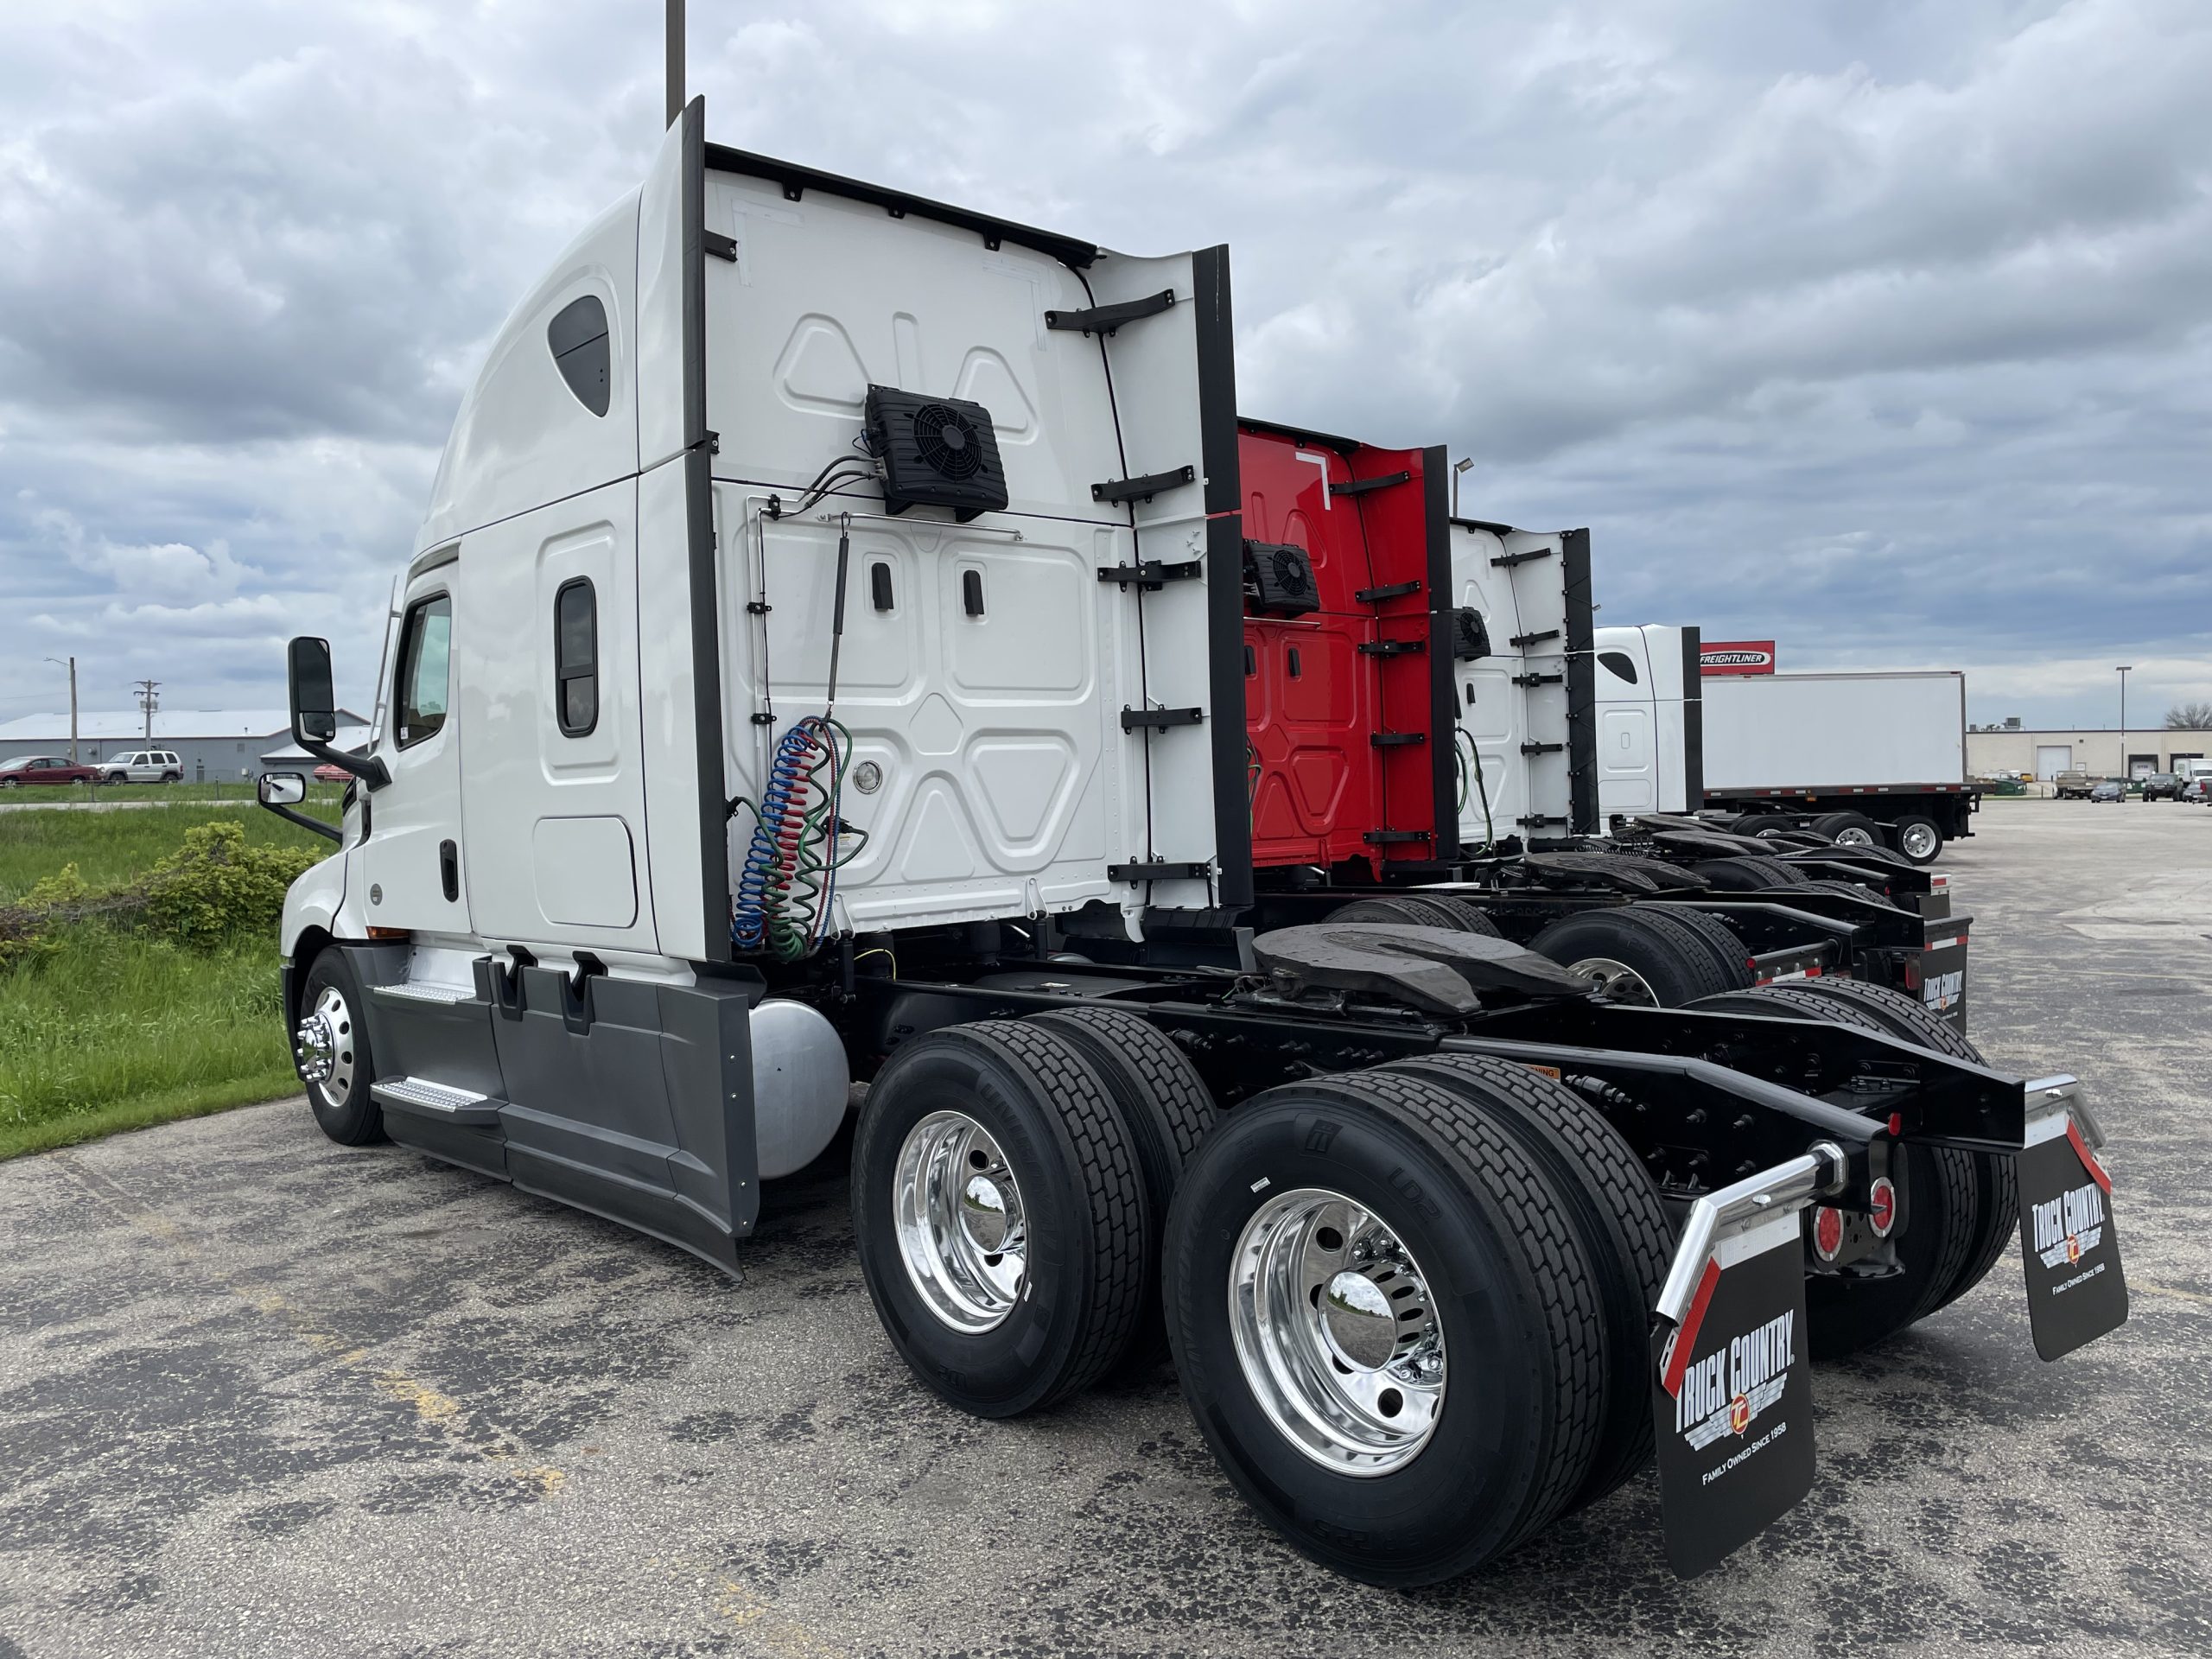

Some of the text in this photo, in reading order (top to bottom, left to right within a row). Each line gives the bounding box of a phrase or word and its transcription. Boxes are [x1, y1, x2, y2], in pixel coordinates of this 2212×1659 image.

[1700, 654, 1763, 664] FREIGHTLINER
[2032, 1183, 2103, 1252] TRUCK COUNTRY
[1730, 1309, 1794, 1400] COUNTRY
[1702, 1421, 1787, 1485] FAMILY OWNED SINCE 1958
